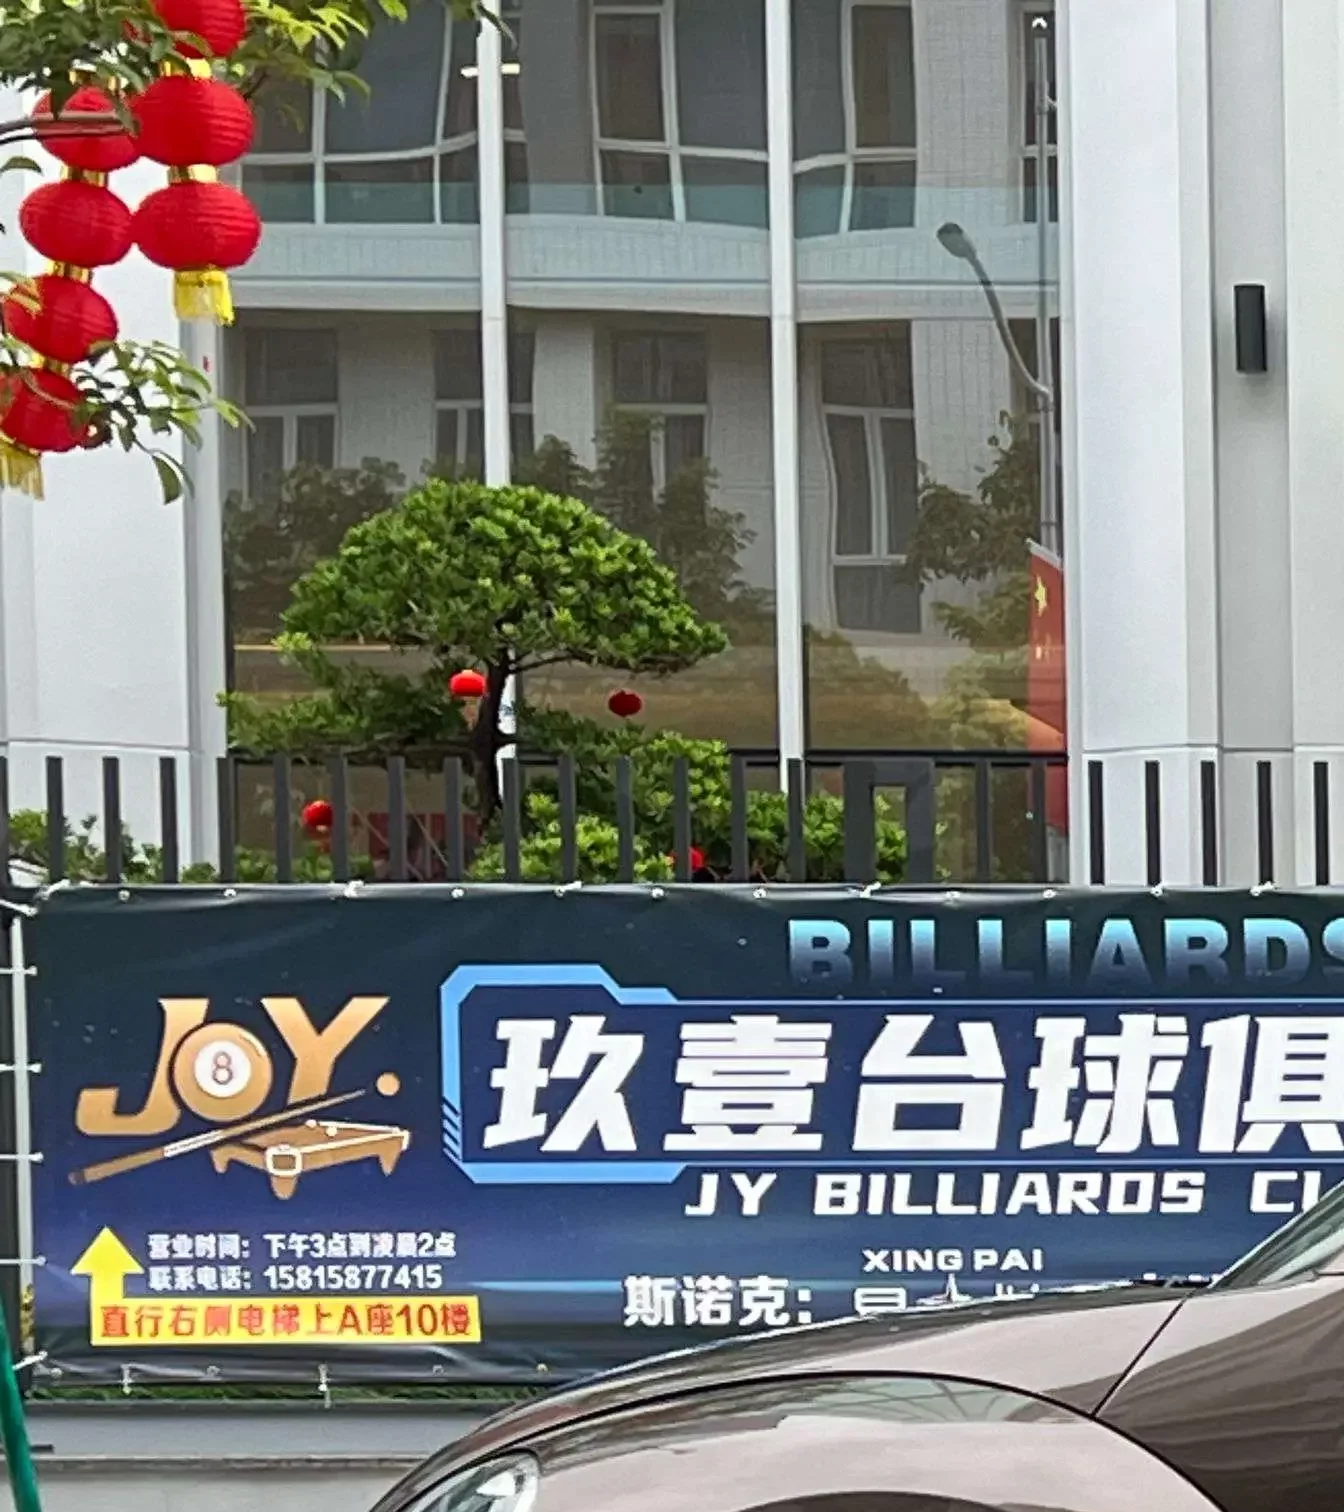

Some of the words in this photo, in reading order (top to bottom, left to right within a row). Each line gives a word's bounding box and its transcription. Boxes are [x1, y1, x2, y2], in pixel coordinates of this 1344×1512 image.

[685, 1173, 777, 1215] JY
[813, 1171, 1206, 1215] BILLIARDS
[861, 1249, 963, 1272] XING
[972, 1249, 1044, 1272] PAI
[99, 1303, 472, 1338] 直行右侧电梯上A座10楼
